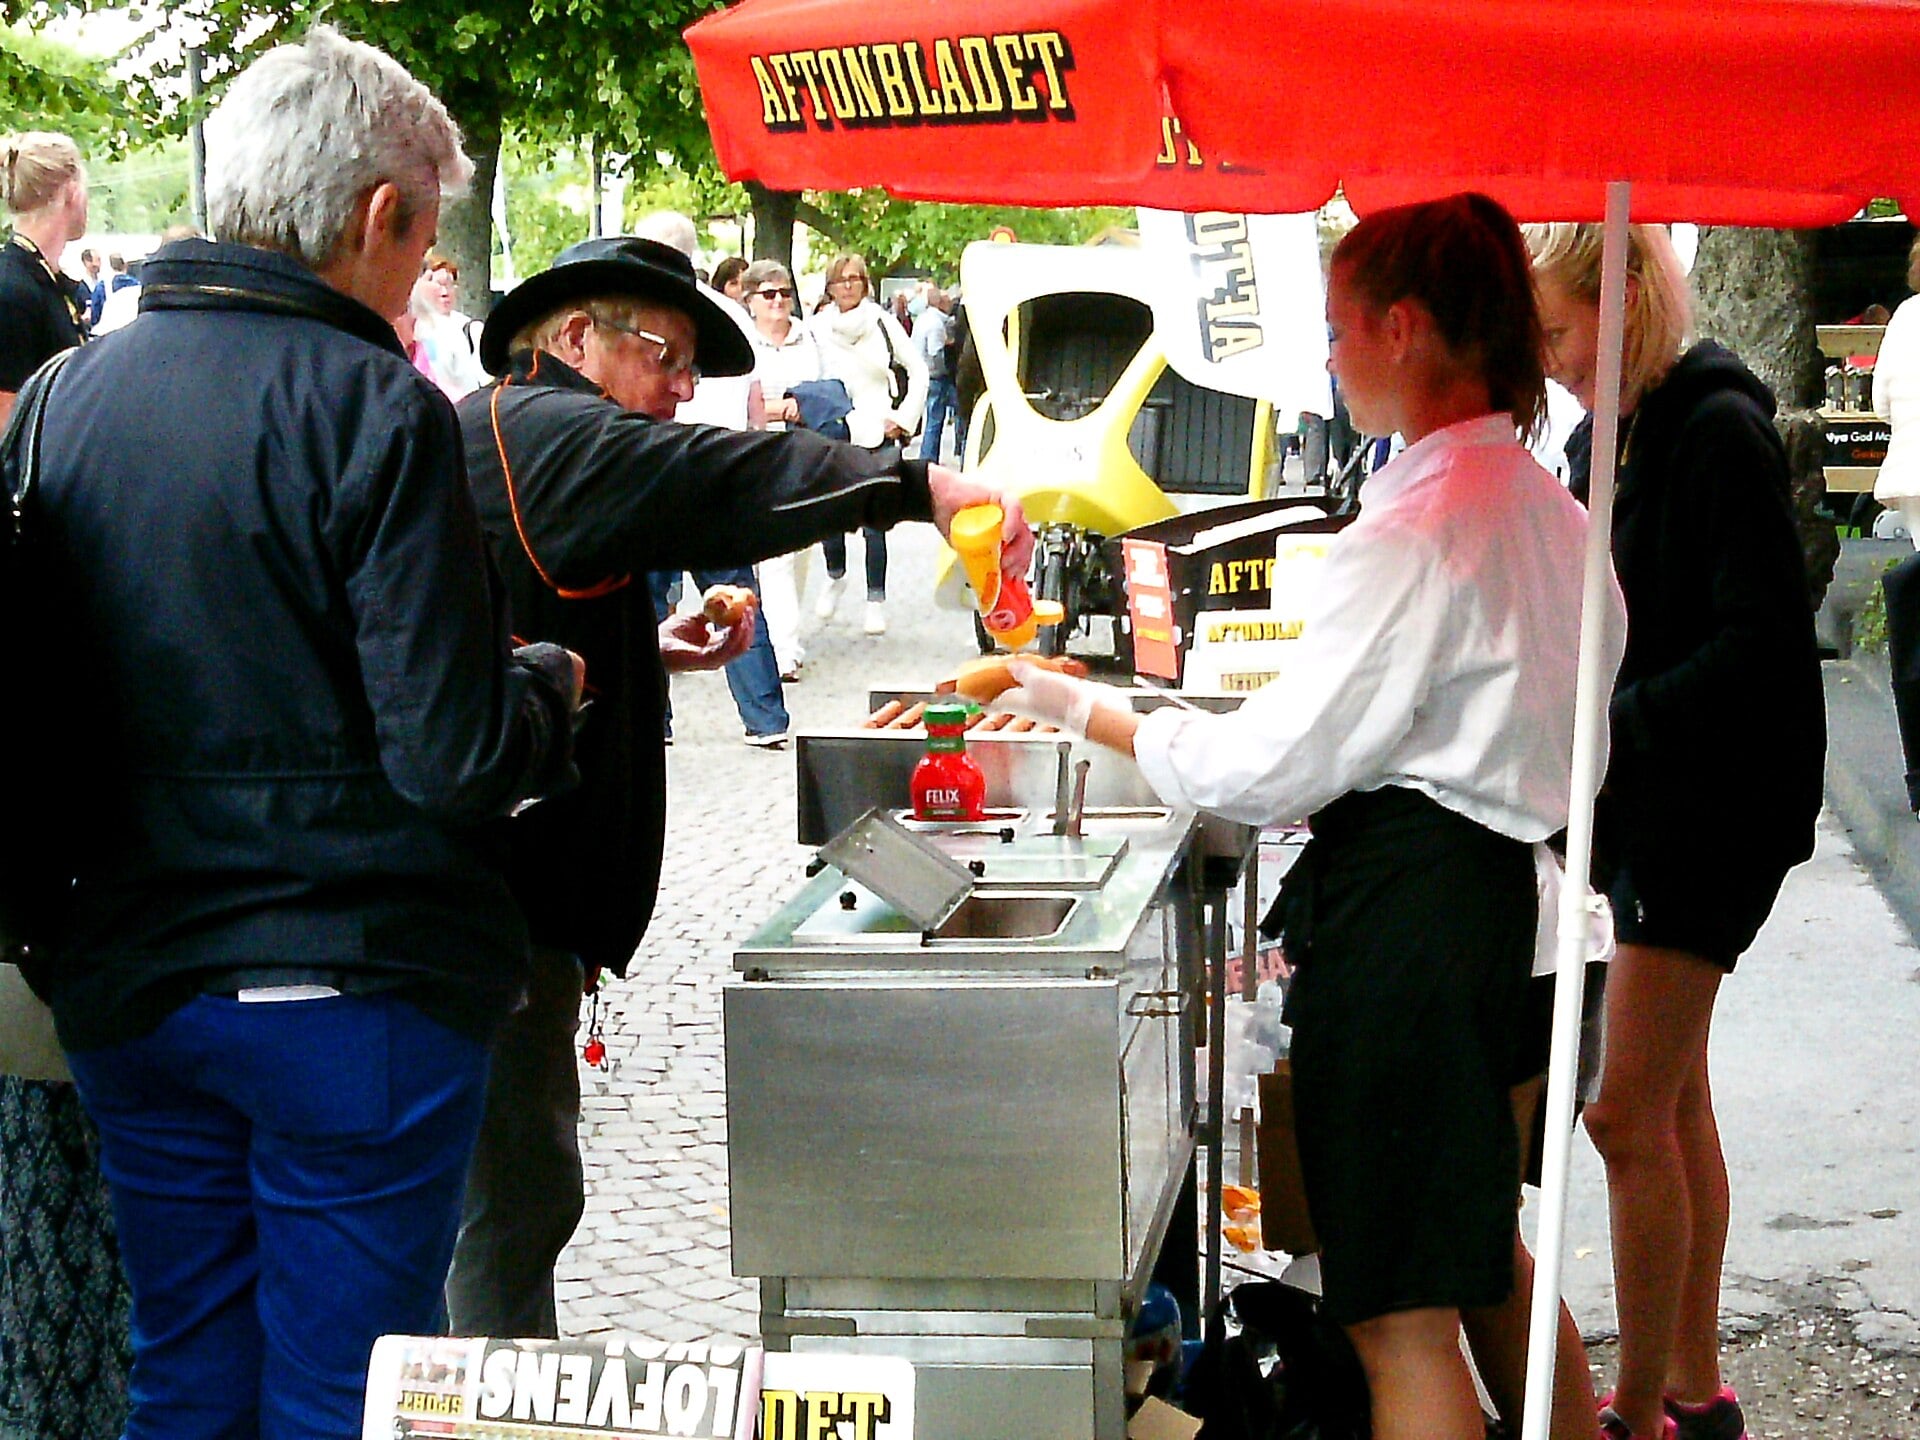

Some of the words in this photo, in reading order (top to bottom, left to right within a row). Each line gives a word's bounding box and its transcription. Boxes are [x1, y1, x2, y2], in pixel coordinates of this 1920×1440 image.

[750, 31, 1073, 131] AFTONBLADET
[1850, 431, 1873, 442] God
[926, 788, 960, 803] FELIX
[397, 1389, 463, 1415] SPORT
